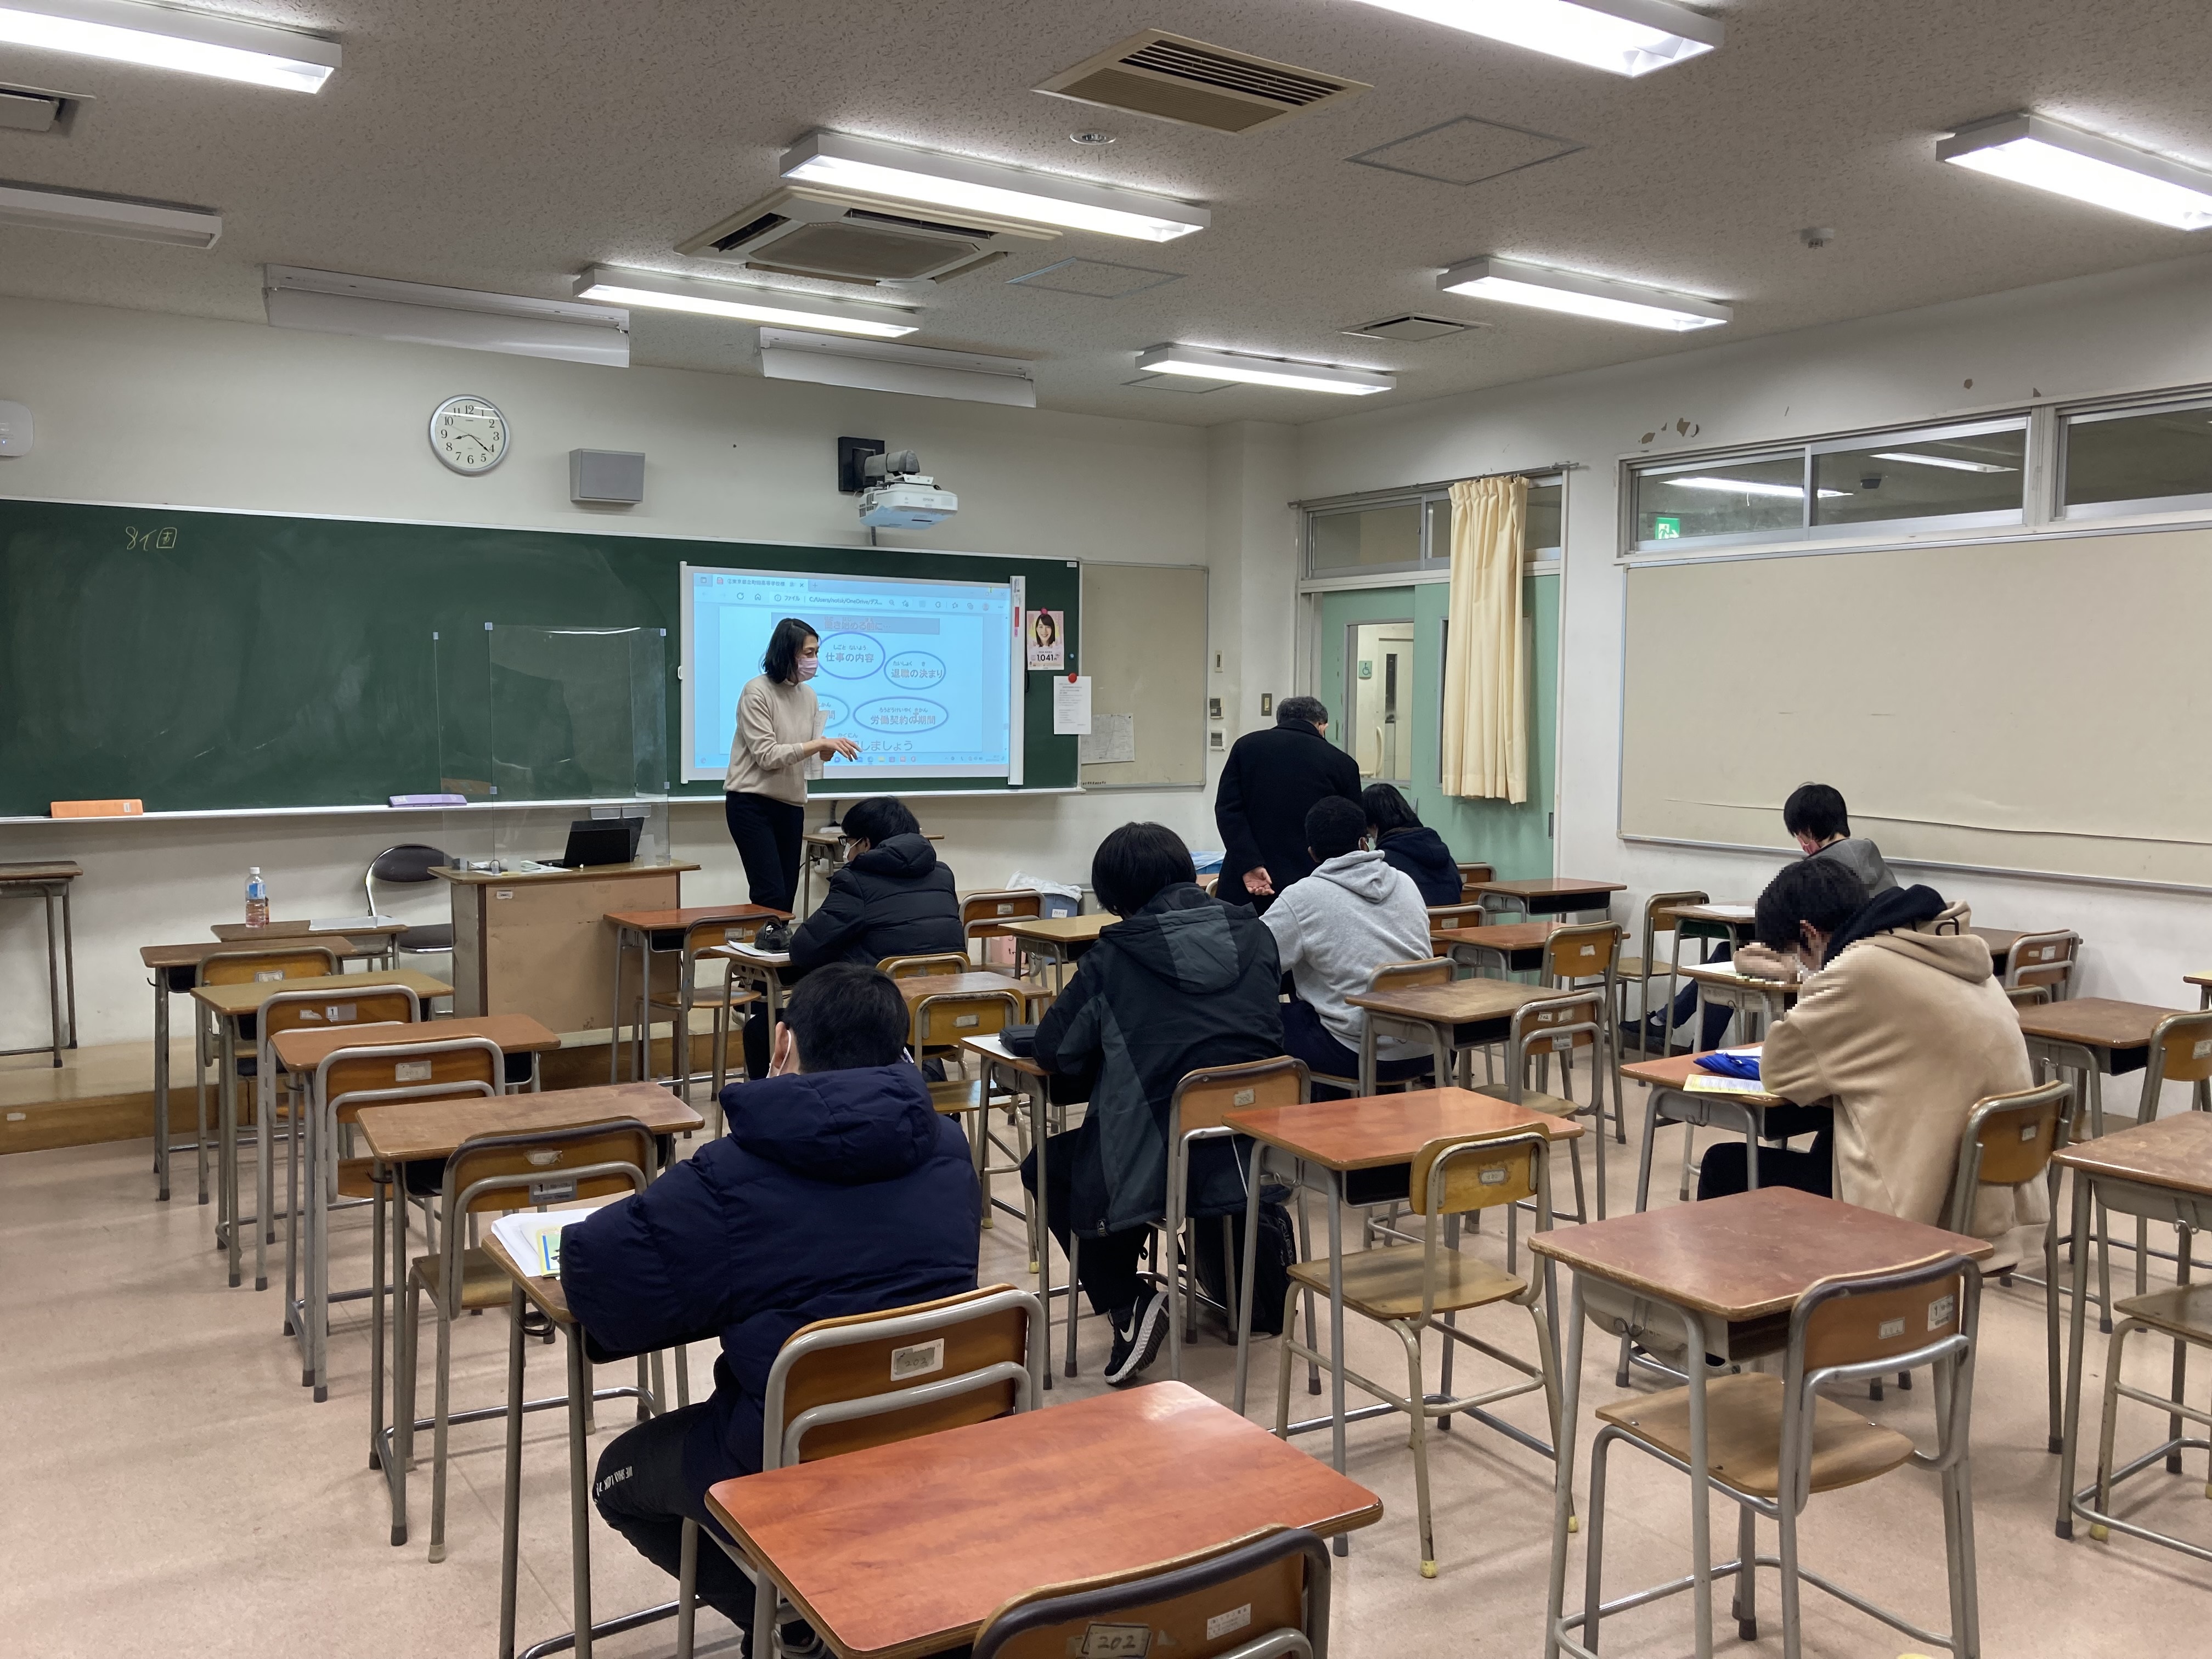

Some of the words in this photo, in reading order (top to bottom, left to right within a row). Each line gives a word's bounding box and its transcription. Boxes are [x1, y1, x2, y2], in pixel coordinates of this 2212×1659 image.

[465, 405, 474, 414] 12
[444, 416, 454, 426] 10
[489, 419, 495, 428] 2
[441, 429, 448, 438] 9
[493, 431, 500, 441] 3
[446, 442, 453, 451] 8
[489, 443, 495, 453] 4
[455, 452, 461, 461] 7
[467, 455, 474, 464] 6
[481, 453, 487, 462] 5
[825, 652, 874, 663] 仕事の内容
[891, 668, 943, 679] 退職の決まり
[871, 715, 936, 725] 労働契約の期間
[1237, 1093, 1251, 1104] 202
[904, 1357, 928, 1367] 202
[1097, 1635, 1137, 1651] 202
